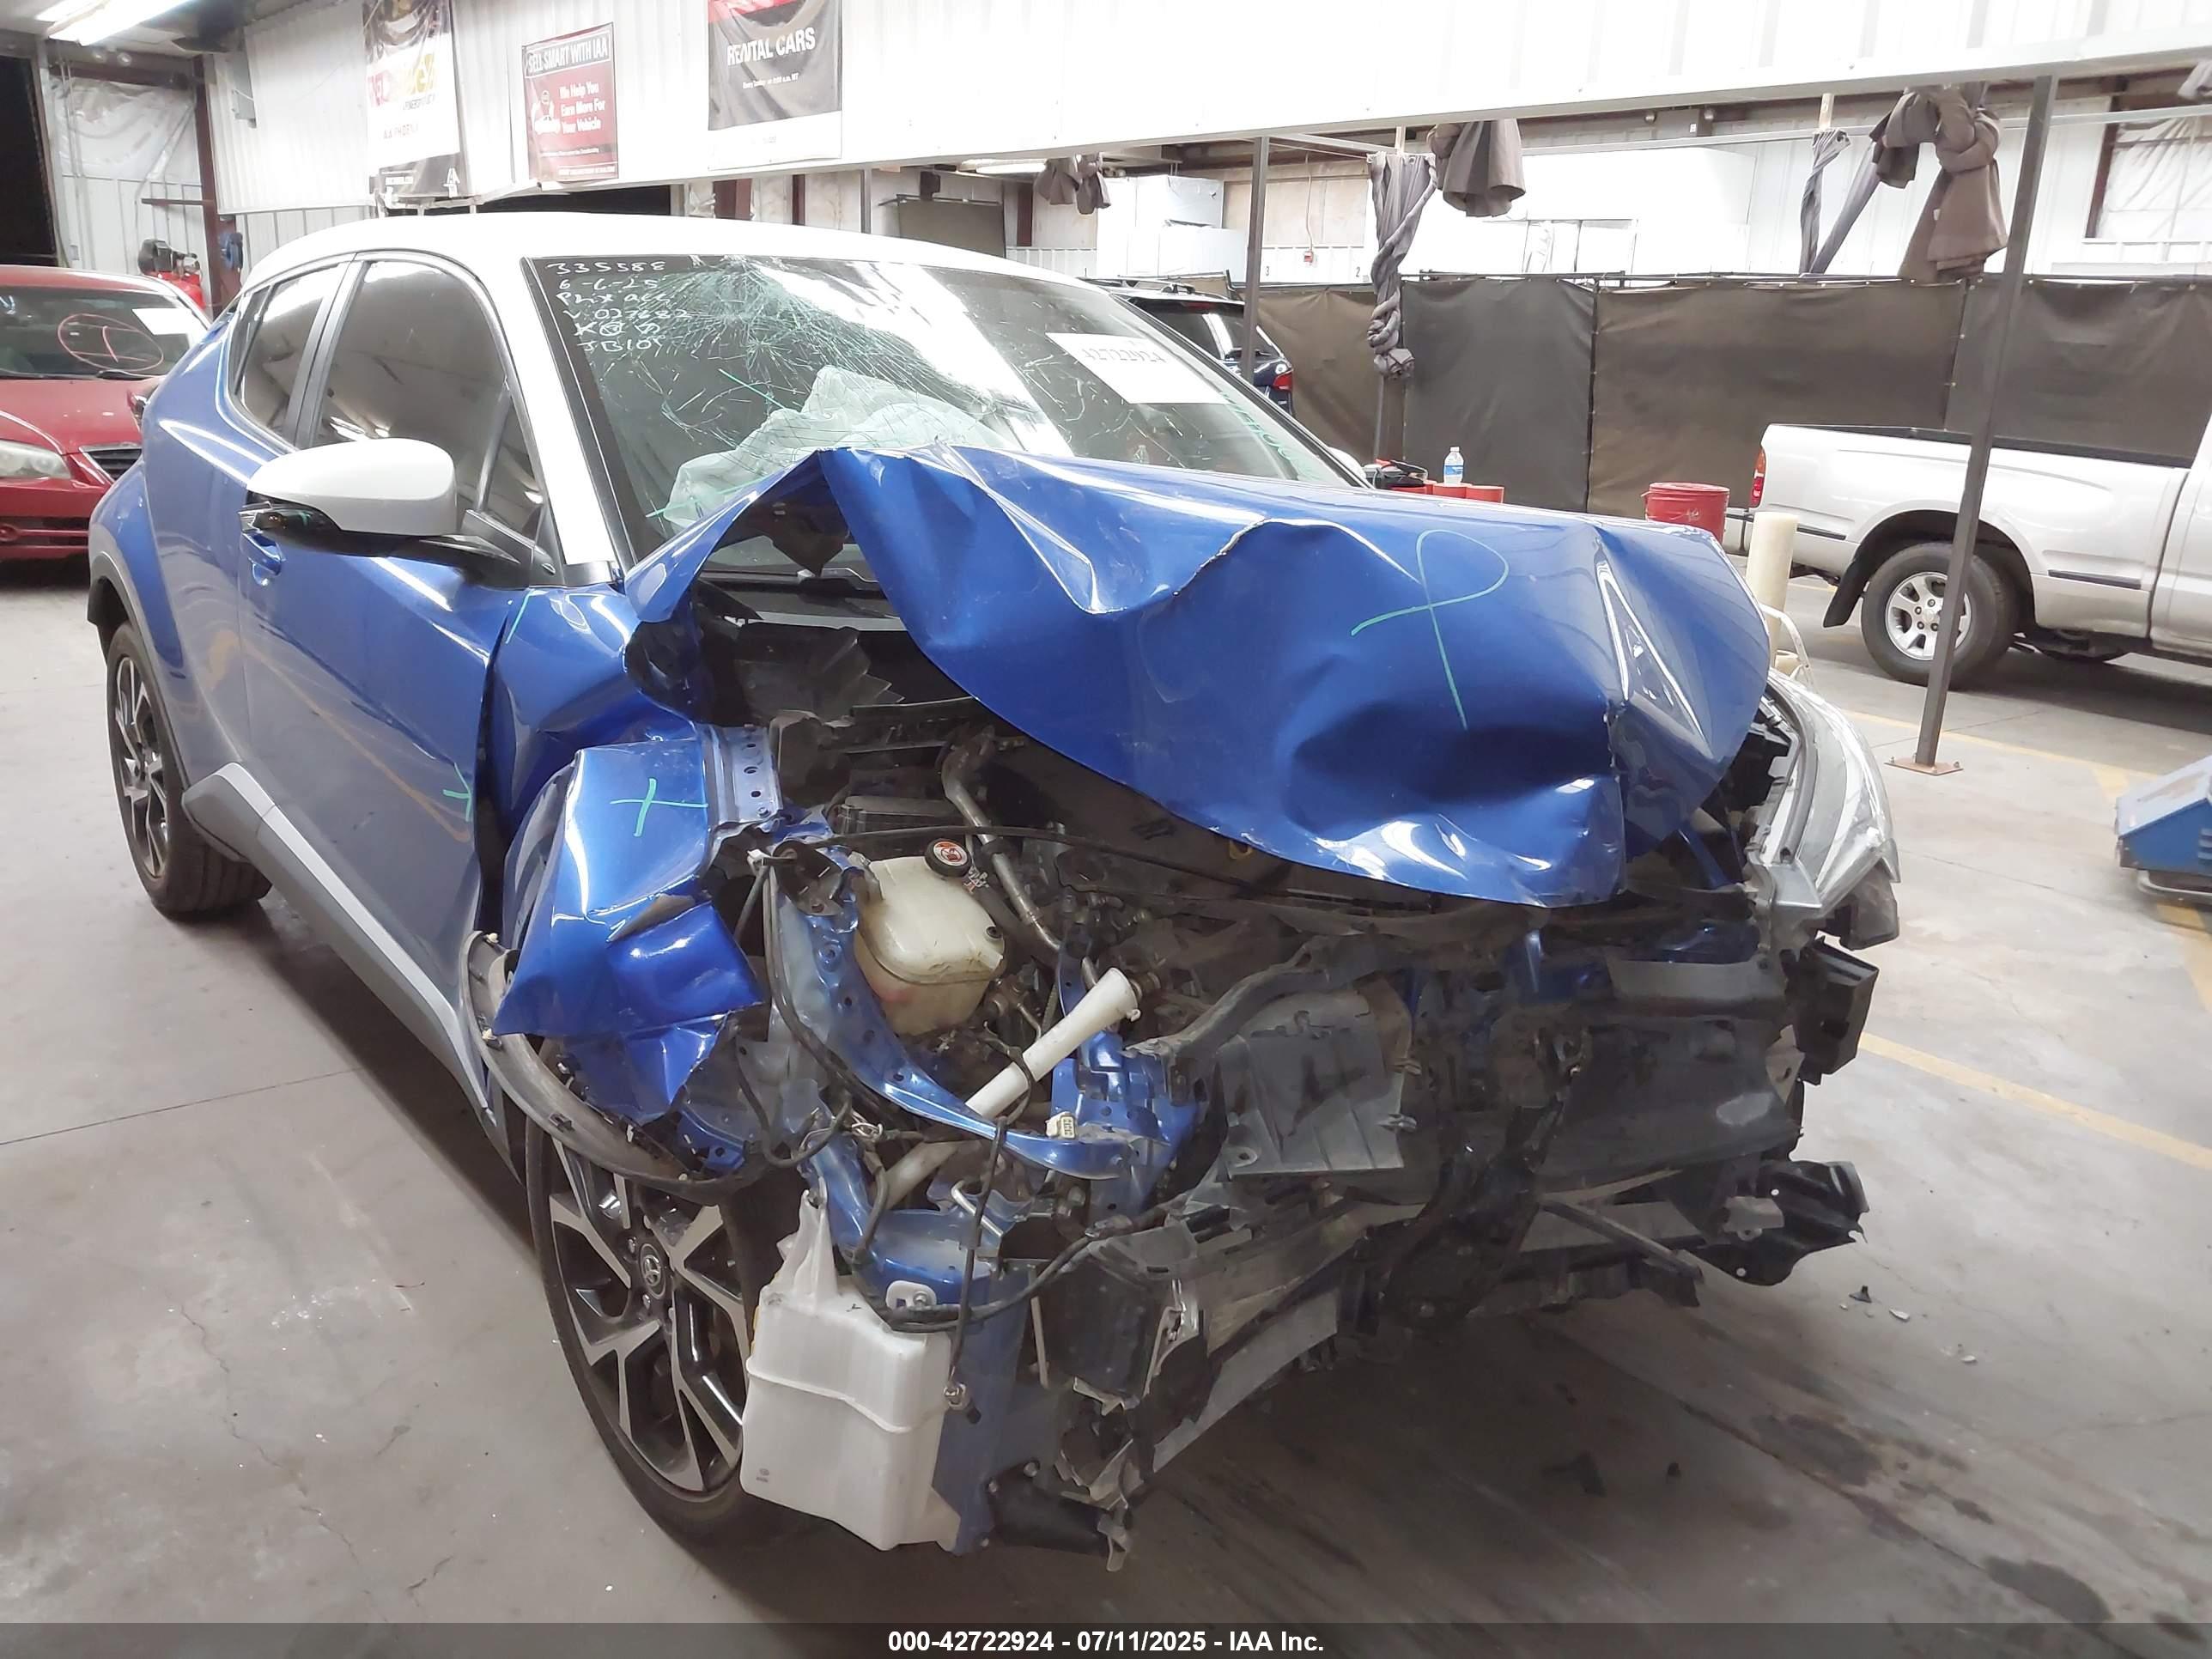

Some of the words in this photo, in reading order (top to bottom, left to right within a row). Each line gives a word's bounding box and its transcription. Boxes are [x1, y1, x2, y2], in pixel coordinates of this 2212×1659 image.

[528, 53, 544, 73] SELL
[543, 45, 570, 70] SMART
[570, 40, 592, 64] WITH
[592, 37, 608, 58] IAA
[727, 38, 774, 65] RENTAL
[775, 27, 816, 56] CARS
[570, 83, 586, 99] Help
[586, 82, 599, 95] You
[593, 98, 605, 112] For
